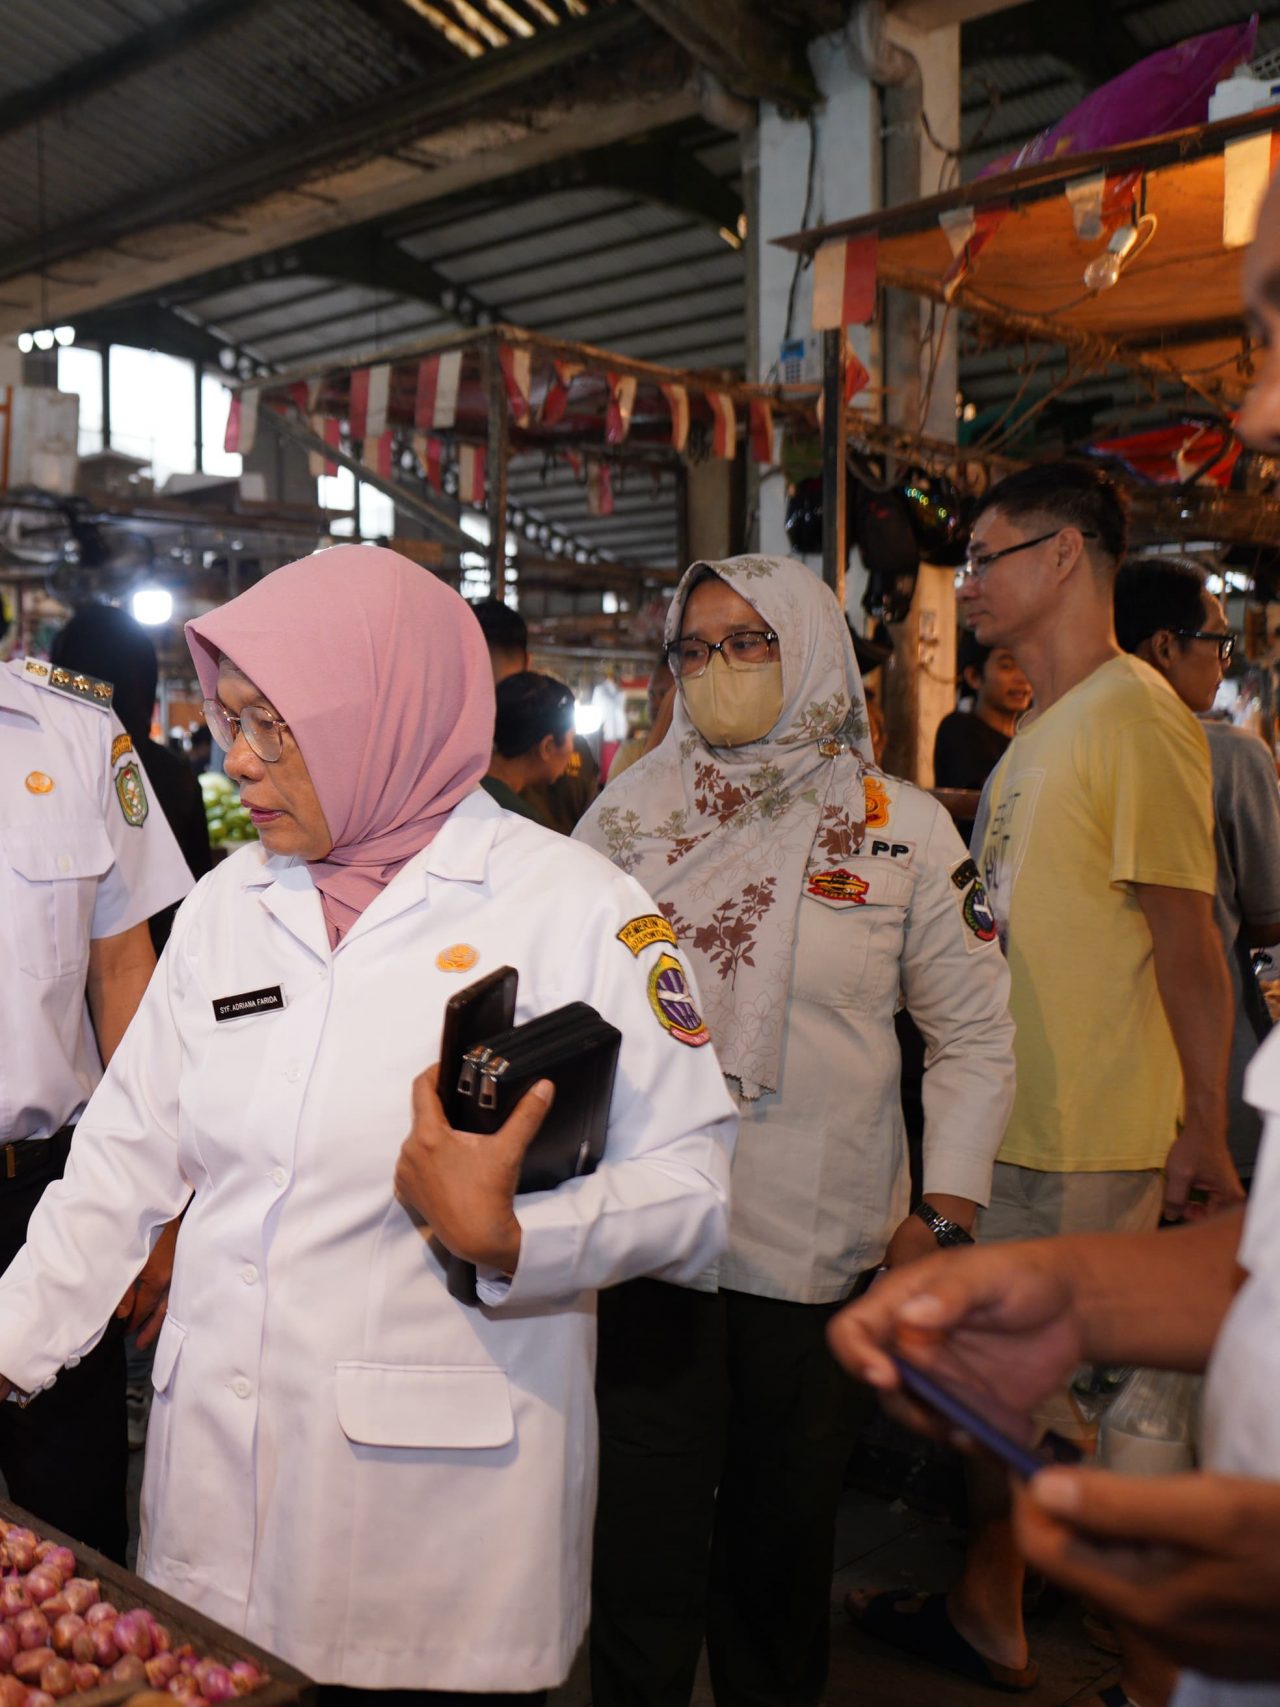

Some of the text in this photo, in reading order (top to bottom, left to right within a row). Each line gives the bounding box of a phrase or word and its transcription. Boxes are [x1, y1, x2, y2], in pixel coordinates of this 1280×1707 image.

[871, 840, 909, 857] PP
[232, 999, 256, 1011] ADRIANA
[256, 995, 278, 1006] FARIDA
